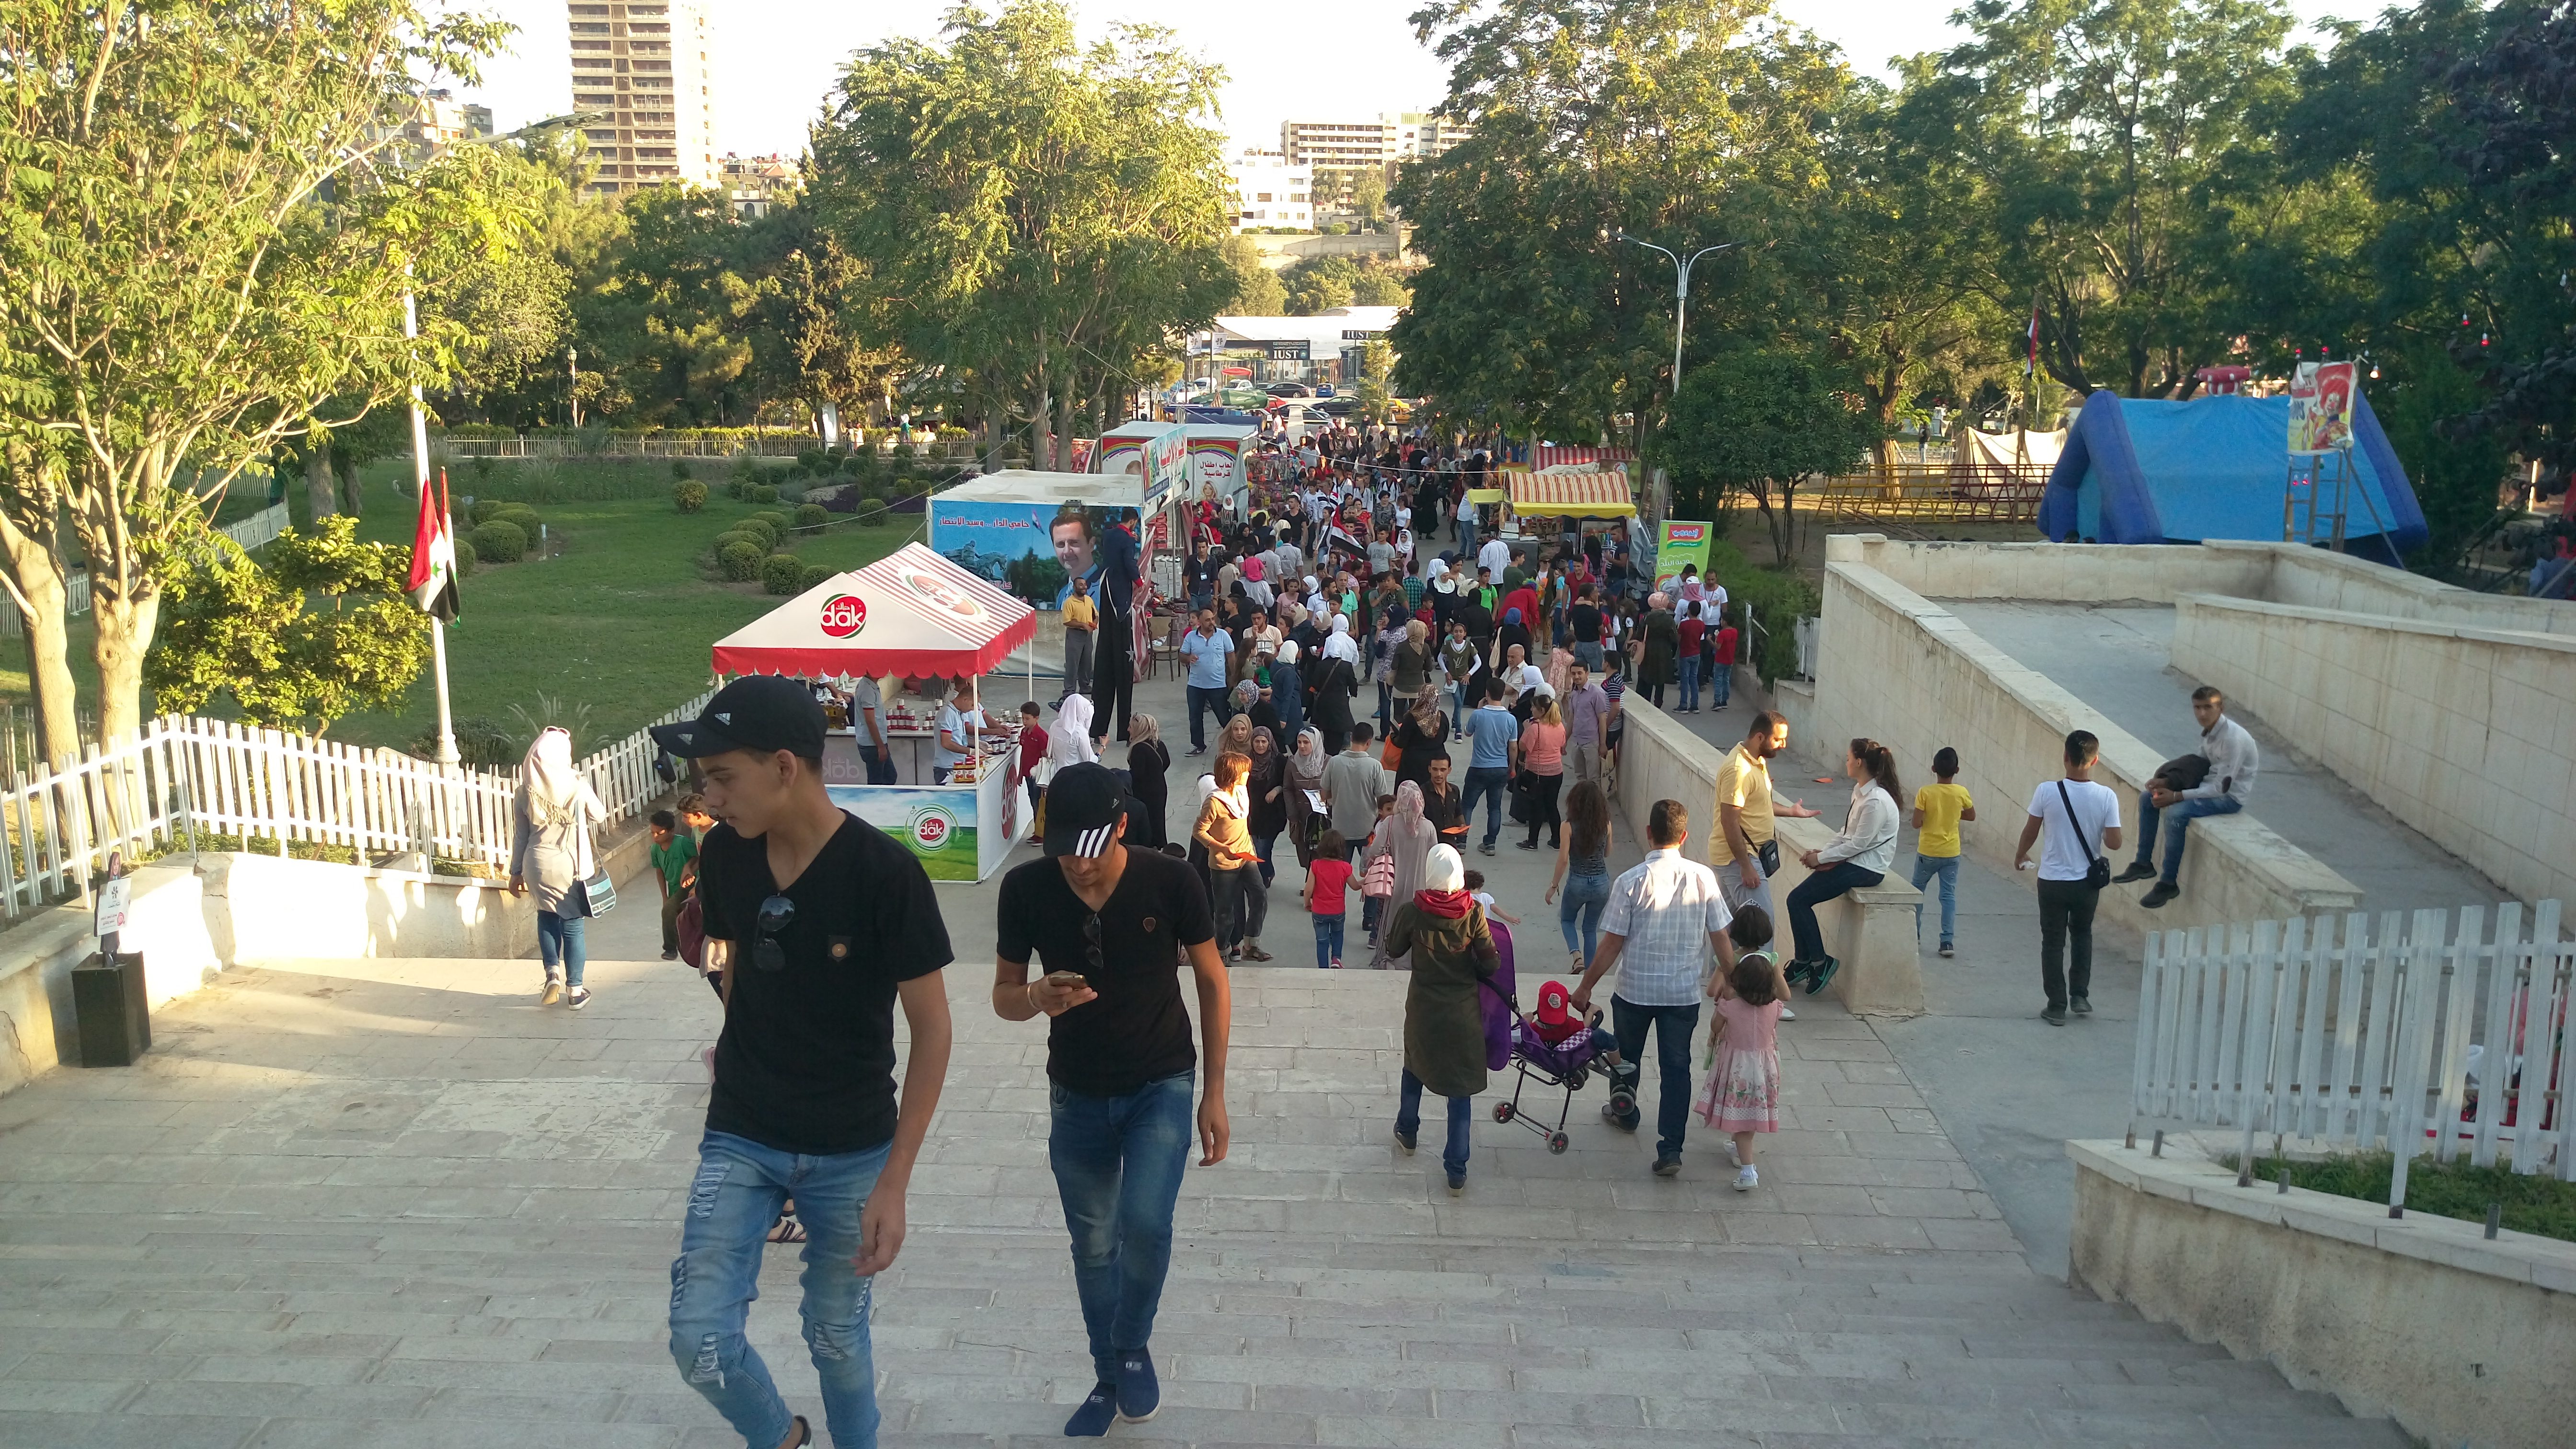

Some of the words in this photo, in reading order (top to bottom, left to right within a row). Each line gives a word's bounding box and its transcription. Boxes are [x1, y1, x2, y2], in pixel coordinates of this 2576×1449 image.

[1347, 331, 1370, 339] IUST
[1274, 350, 1299, 359] IUST
[1204, 469, 1230, 478] قرطاسية
[1009, 519, 1030, 529] حامي
[1660, 560, 1674, 568] البلد
[820, 604, 863, 627] dak
[1001, 778, 1016, 825] dak
[920, 823, 943, 835] dak
